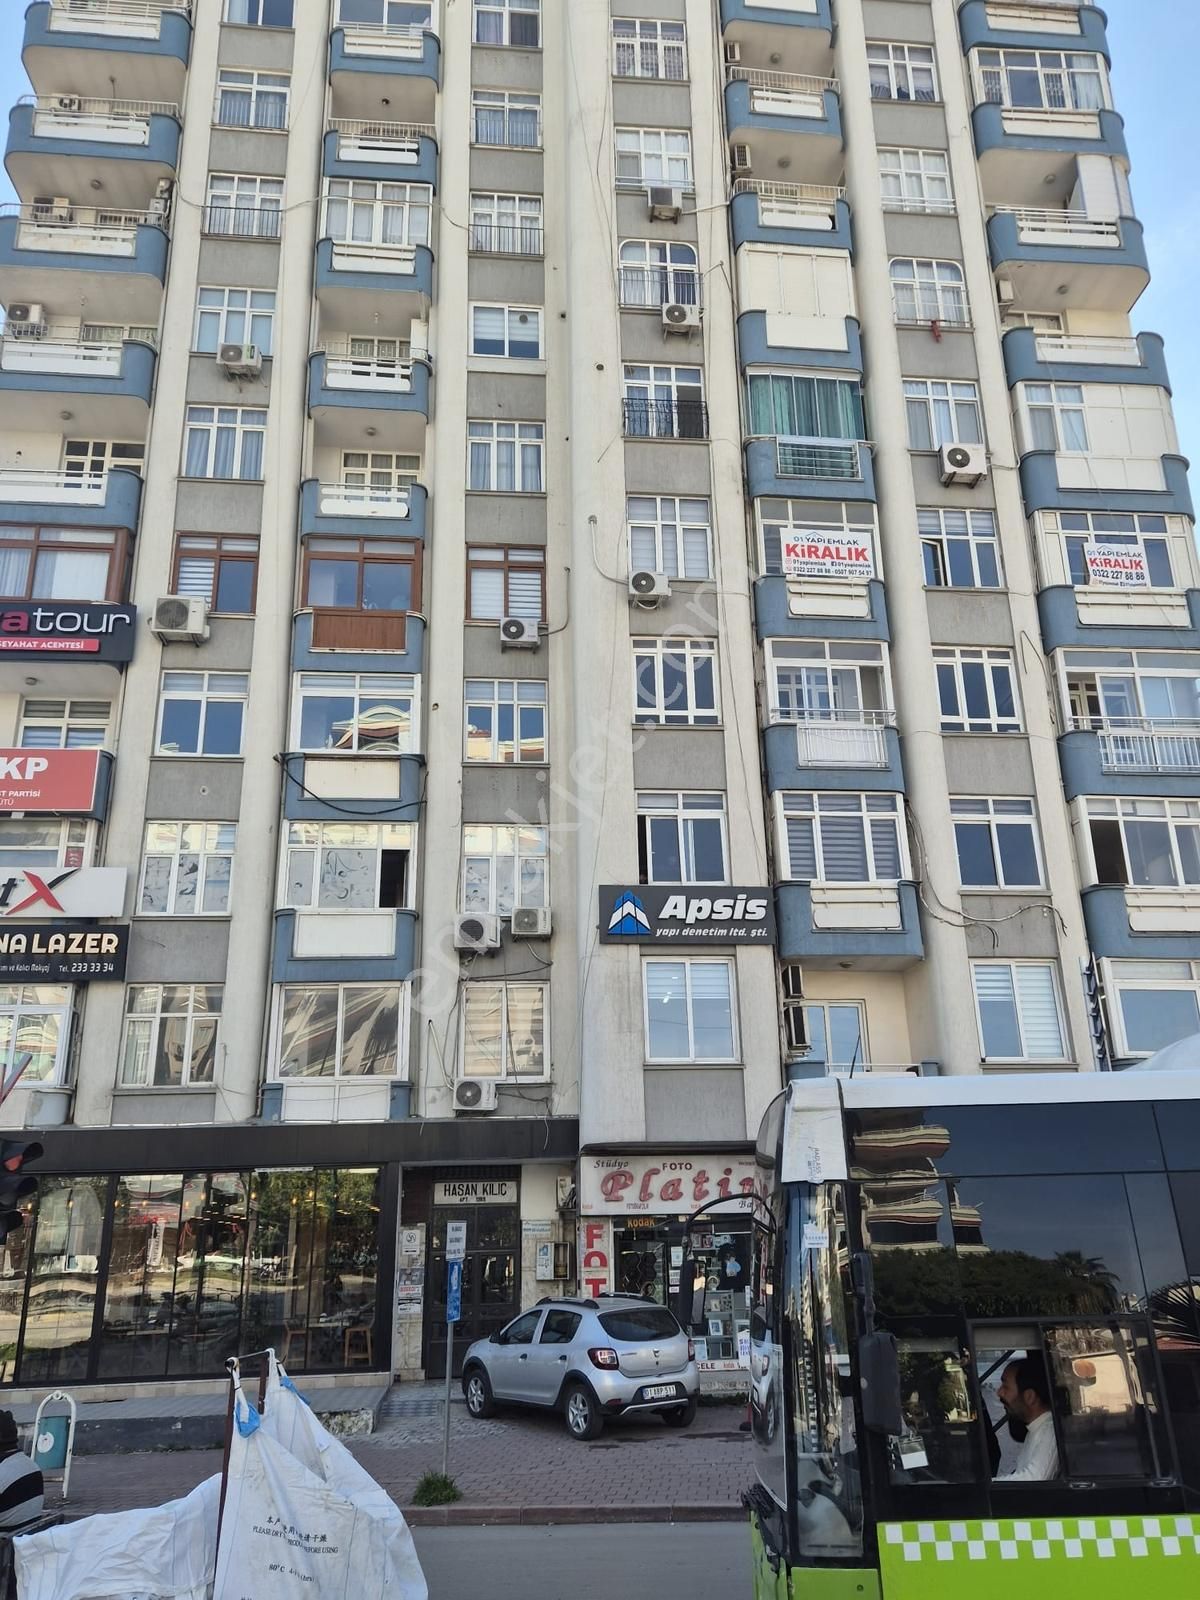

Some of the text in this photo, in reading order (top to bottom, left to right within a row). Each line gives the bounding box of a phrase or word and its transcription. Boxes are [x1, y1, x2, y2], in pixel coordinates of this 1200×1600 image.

[806, 536, 826, 544] YAPI
[827, 538, 859, 546] EMLAK
[1092, 569, 1145, 580] 0322 227 88 88
[658, 893, 768, 924] Apsis
[655, 927, 768, 938] yapı denetim ltd. şti.
[31, 933, 119, 954] LAZER
[71, 962, 88, 973] 233
[89, 962, 101, 973] 33
[102, 962, 114, 973] 34
[593, 1159, 692, 1171] Stüdyo FOTO
[443, 1183, 478, 1197] HASAN
[252, 1525, 272, 1535] PLEASE
[321, 1546, 339, 1554] USING
